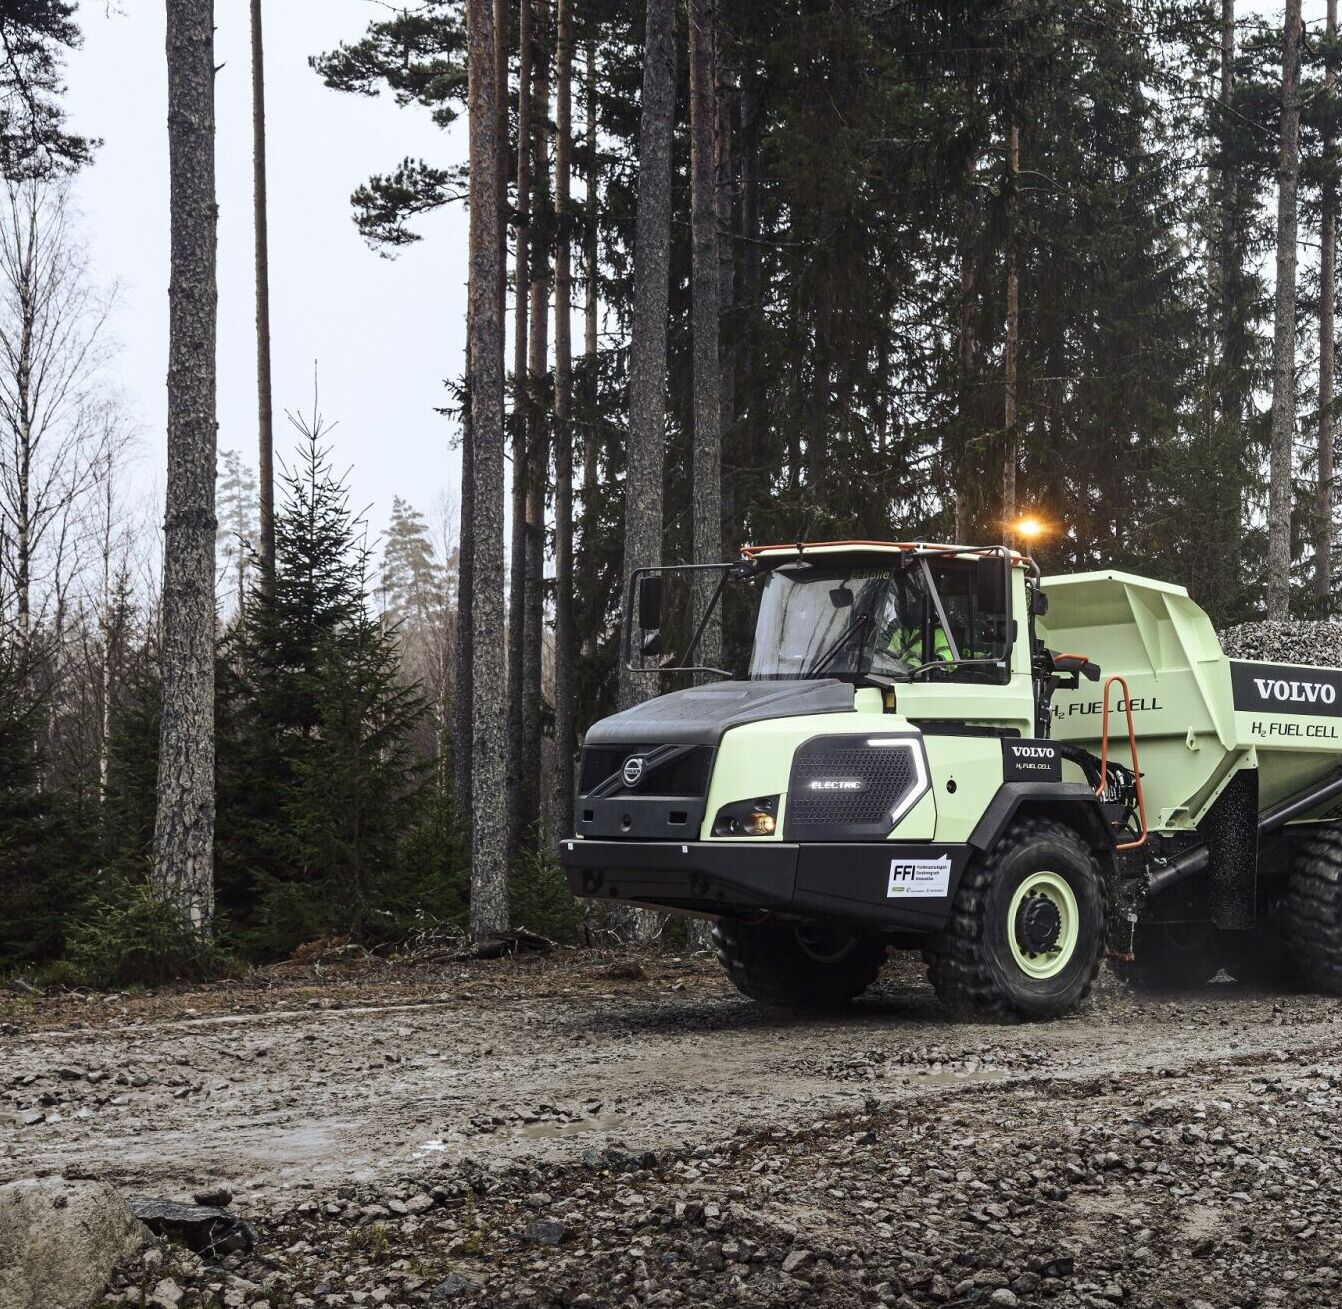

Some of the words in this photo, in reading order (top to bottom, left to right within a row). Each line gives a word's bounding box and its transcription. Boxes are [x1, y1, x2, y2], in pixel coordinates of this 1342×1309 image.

[1254, 678, 1336, 704] VOLVO
[1117, 698, 1163, 713] CELL
[1251, 722, 1267, 737] H2
[1269, 723, 1303, 736] FUEL
[1306, 725, 1339, 738] CELL
[1011, 746, 1055, 758] VOLVO
[811, 781, 861, 789] ELECTRIC
[893, 865, 916, 881] FFI
